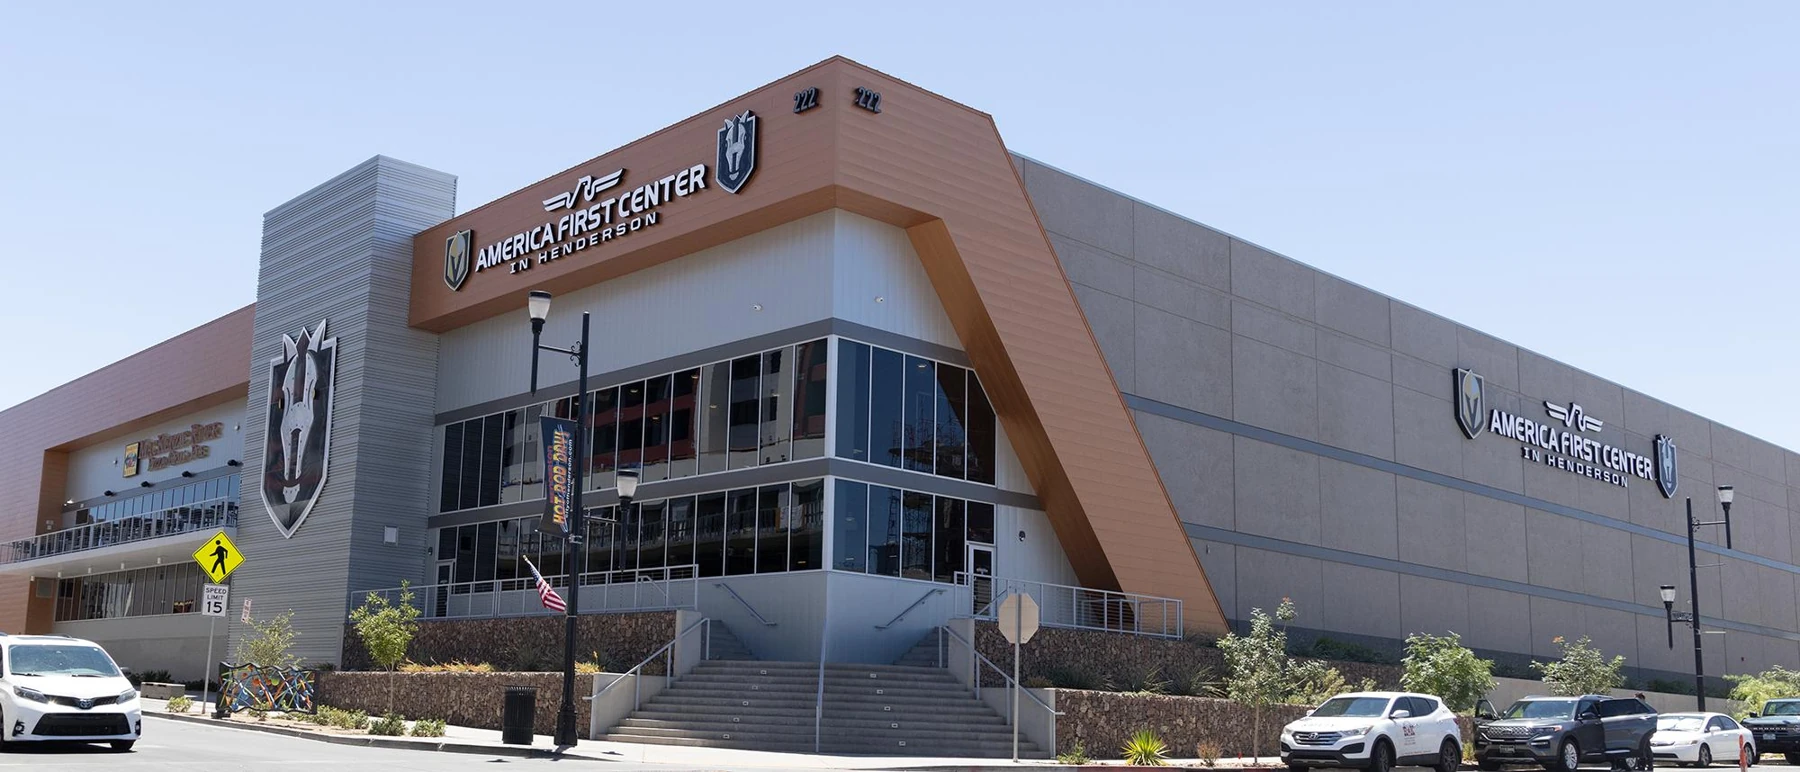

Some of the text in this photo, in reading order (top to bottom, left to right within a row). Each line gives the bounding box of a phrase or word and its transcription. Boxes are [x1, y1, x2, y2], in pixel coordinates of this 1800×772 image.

[793, 86, 818, 113] 222
[858, 86, 881, 113] 222
[475, 163, 706, 272] AMERICA FIRST CENTER
[510, 211, 658, 274] IN HENDERSON
[1490, 409, 1653, 480] AMERICA FIRST CENTER
[552, 466, 567, 495] ROD
[1523, 447, 1628, 488] IN HENDERSON
[552, 496, 565, 524] HOT
[205, 587, 226, 595] SPEED
[207, 601, 222, 613] 15
